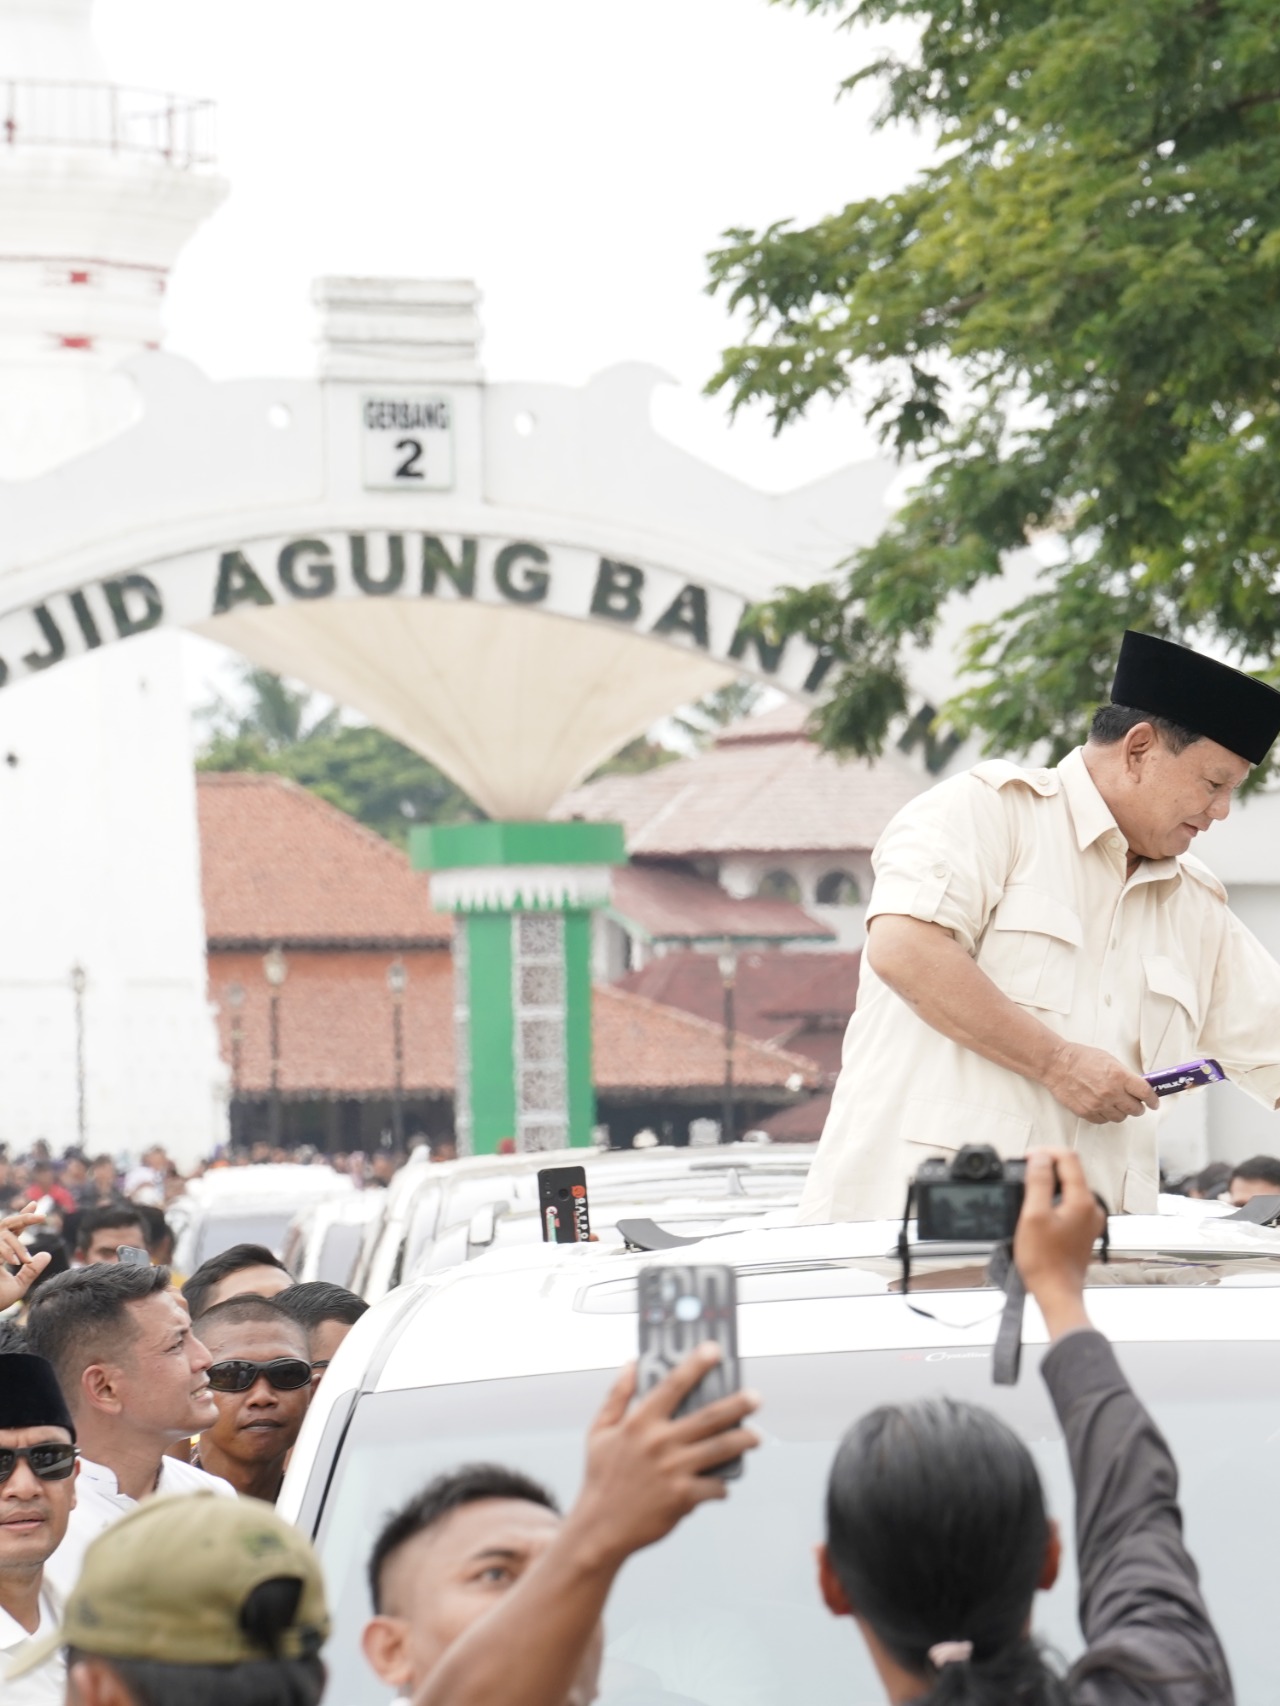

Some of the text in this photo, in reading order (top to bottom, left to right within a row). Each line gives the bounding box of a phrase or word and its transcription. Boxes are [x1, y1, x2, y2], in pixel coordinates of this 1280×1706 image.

[364, 400, 449, 430] GERBANG
[395, 439, 425, 478] 2
[212, 535, 550, 616] AGUNG
